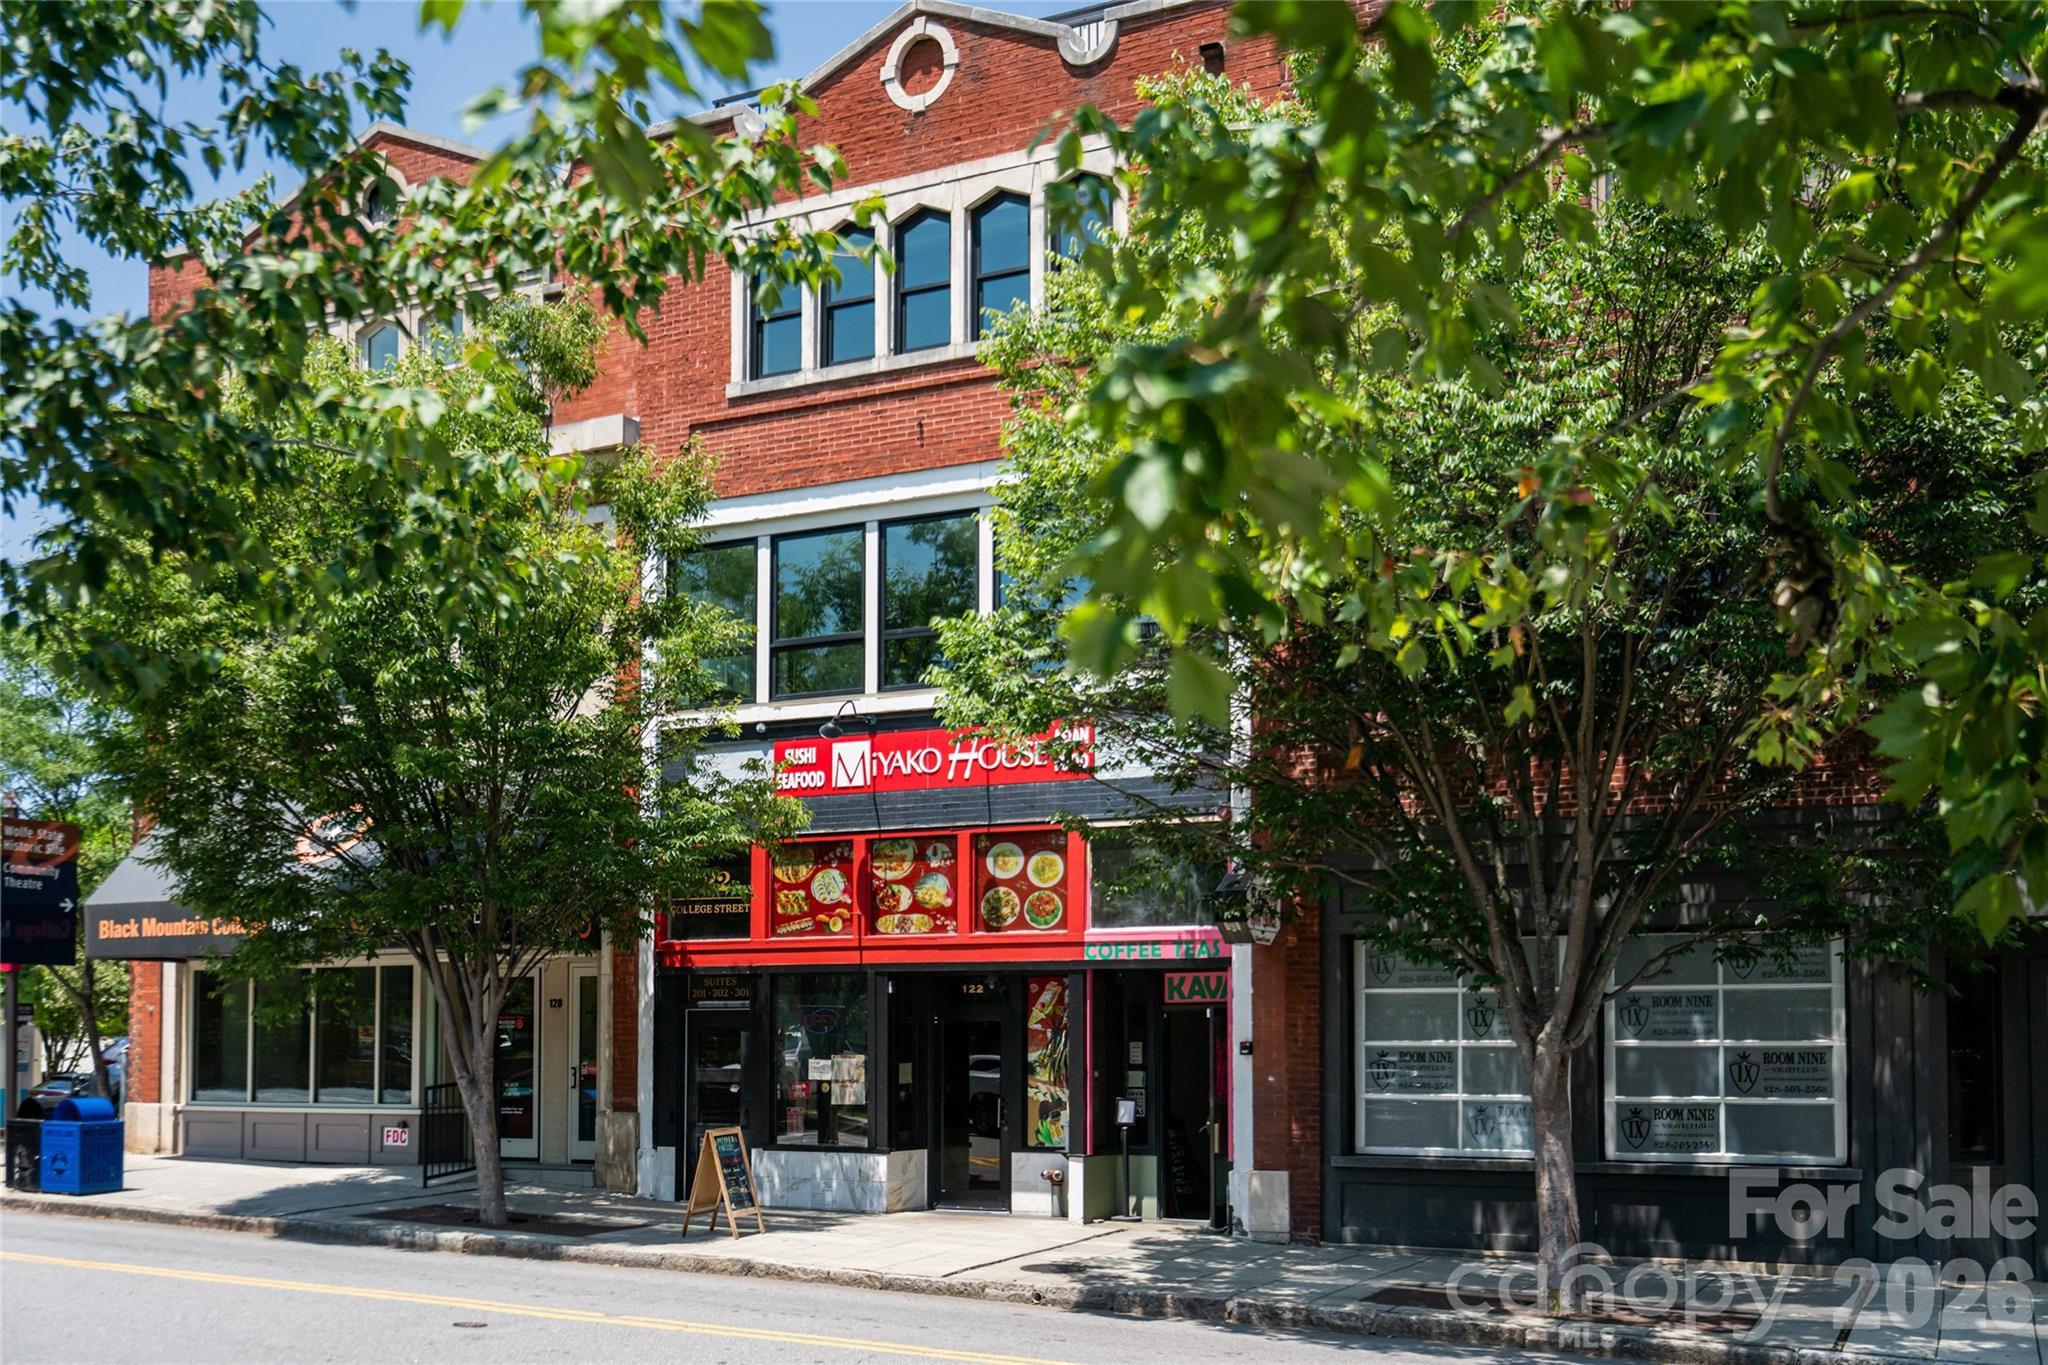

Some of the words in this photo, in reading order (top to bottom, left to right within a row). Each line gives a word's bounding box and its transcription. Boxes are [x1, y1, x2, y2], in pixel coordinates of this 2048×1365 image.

[784, 746, 816, 765] SUSHI
[776, 771, 826, 790] SEAFOOD
[36, 829, 65, 841] State
[46, 844, 65, 855] Site
[3, 862, 60, 880] Community
[4, 876, 43, 890] Theatre
[671, 904, 713, 915] COLLEGE
[714, 903, 751, 913] STREET
[99, 918, 139, 940] Black
[142, 916, 209, 937] Mountain
[1085, 942, 1162, 960] COFFEE
[1172, 939, 1220, 958] TEAS
[703, 976, 737, 987] SUITES
[692, 988, 707, 998] 201
[712, 988, 729, 998] 202
[734, 987, 750, 997] 301
[962, 984, 984, 993] 122
[1652, 995, 1682, 1008] ROOM
[1686, 995, 1713, 1007] NINE
[1474, 1010, 1488, 1027] IX
[1628, 1009, 1642, 1026] IX
[1399, 1051, 1426, 1063] ROOM
[1428, 1051, 1454, 1063] NINE
[1763, 1052, 1794, 1065] ROOM
[1798, 1052, 1827, 1065] NINE
[1738, 1065, 1753, 1083] IX
[1654, 1108, 1683, 1121] ROOM
[1687, 1108, 1715, 1121] NINE
[1629, 1121, 1644, 1138] IX
[385, 1130, 407, 1143] FDC
